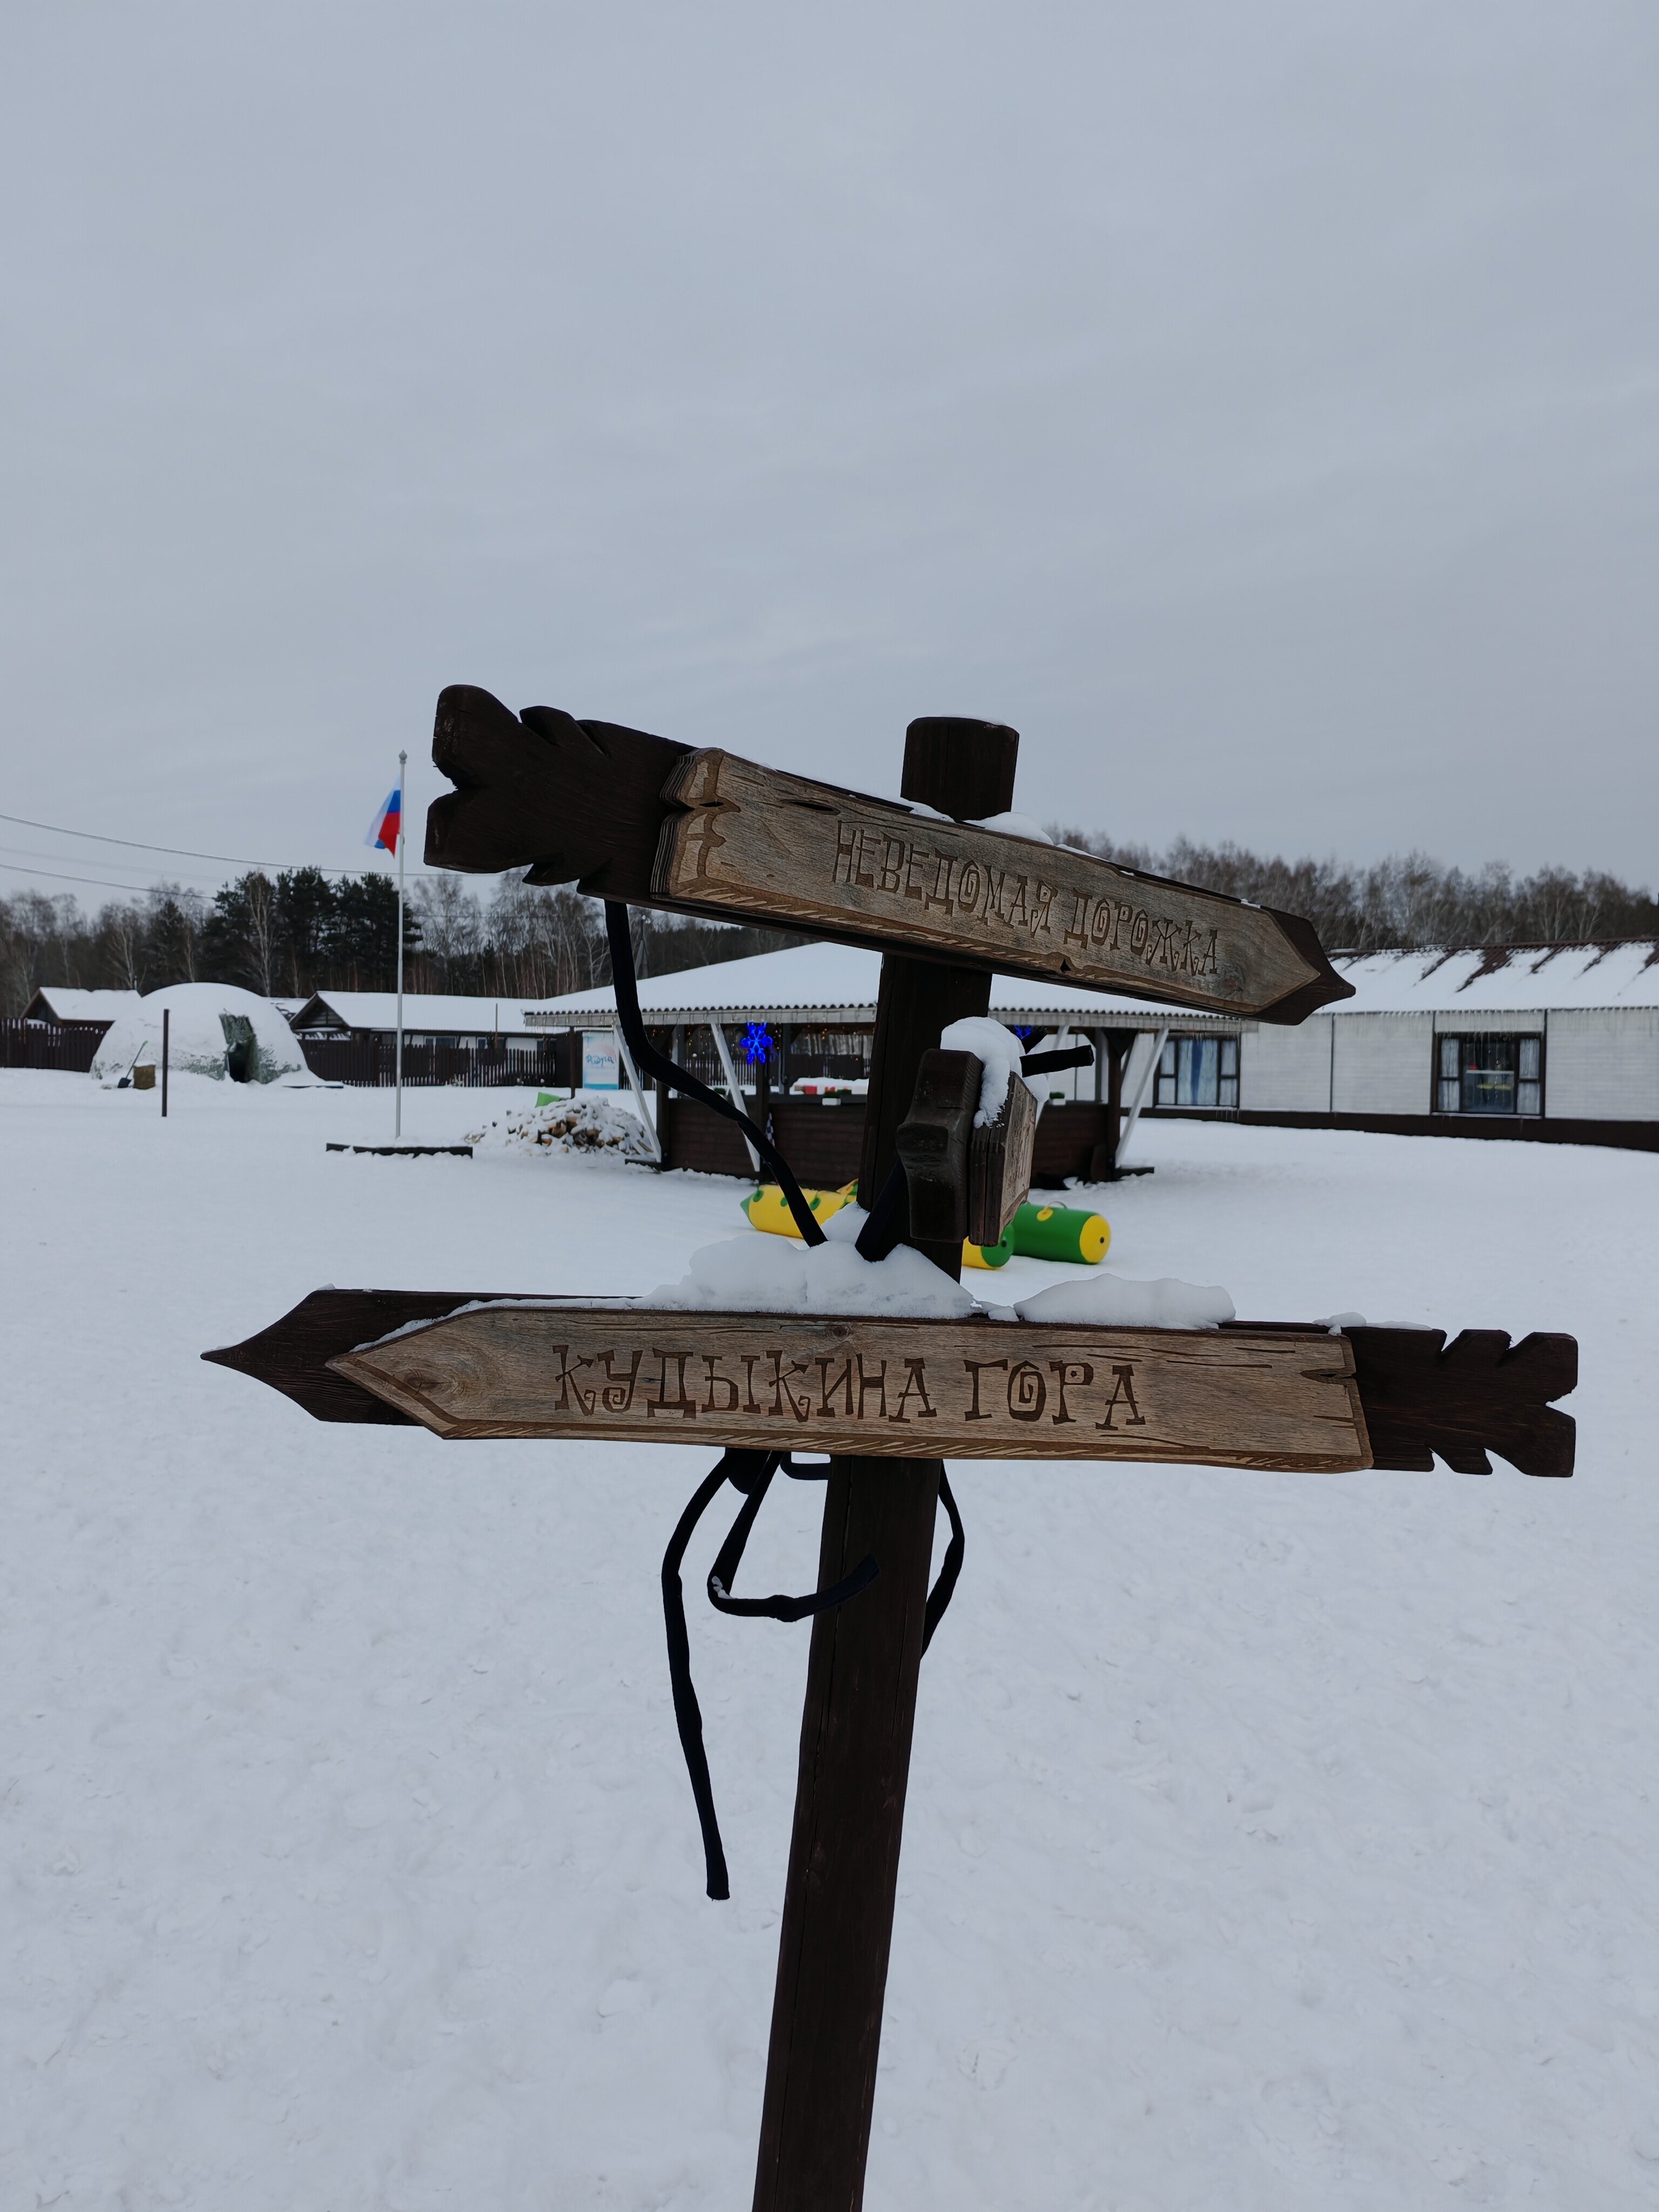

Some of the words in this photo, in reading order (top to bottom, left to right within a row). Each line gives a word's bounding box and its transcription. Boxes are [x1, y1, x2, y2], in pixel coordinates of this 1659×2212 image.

[832, 820, 1058, 938] НЕВЕДОМАЯ
[1063, 887, 1218, 977] ДОРОЖКА
[552, 1344, 938, 1423] КУДЫКИНА
[964, 1358, 1146, 1430] ГОРА
